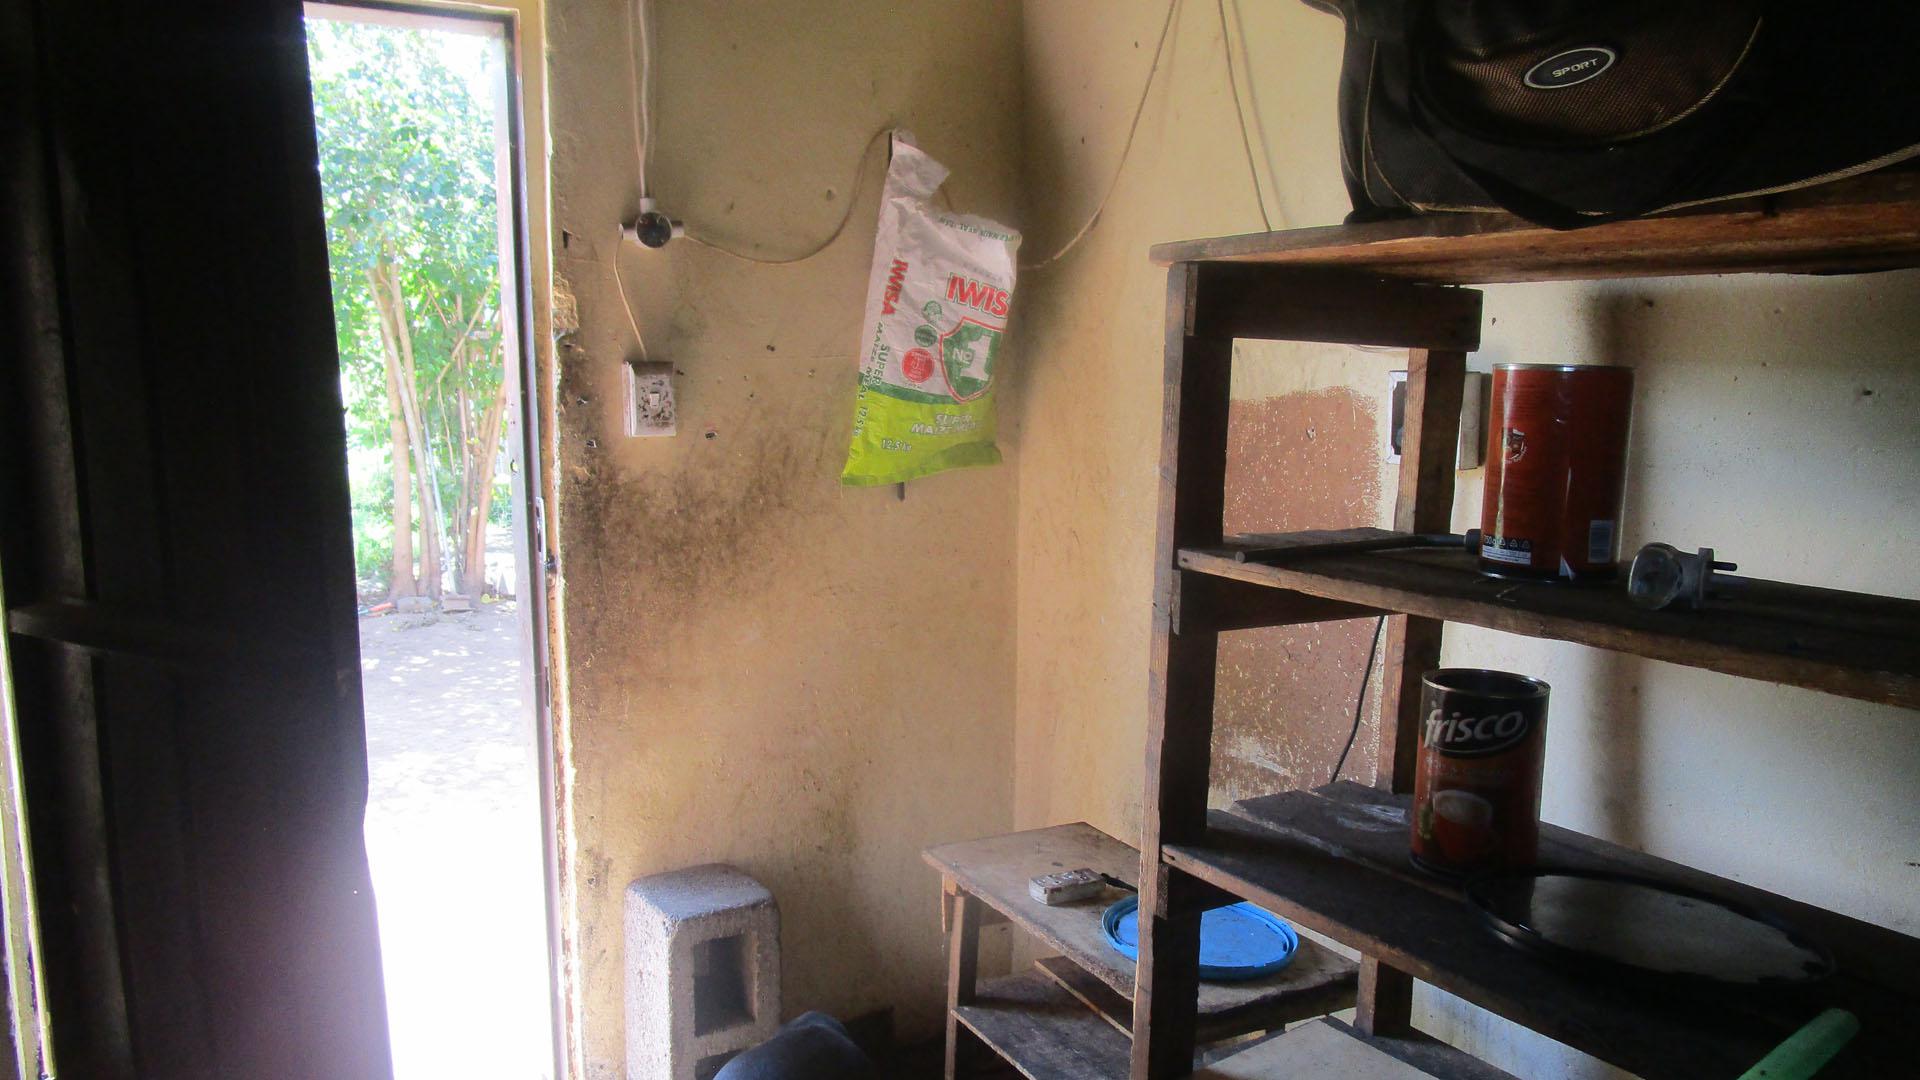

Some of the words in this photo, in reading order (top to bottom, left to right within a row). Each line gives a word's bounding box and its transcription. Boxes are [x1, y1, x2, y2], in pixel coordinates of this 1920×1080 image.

[1552, 58, 1598, 78] SPORT
[880, 258, 909, 315] IWISA
[871, 343, 890, 386] SUPER
[960, 334, 992, 382] 1
[1424, 708, 1524, 748] frisco
